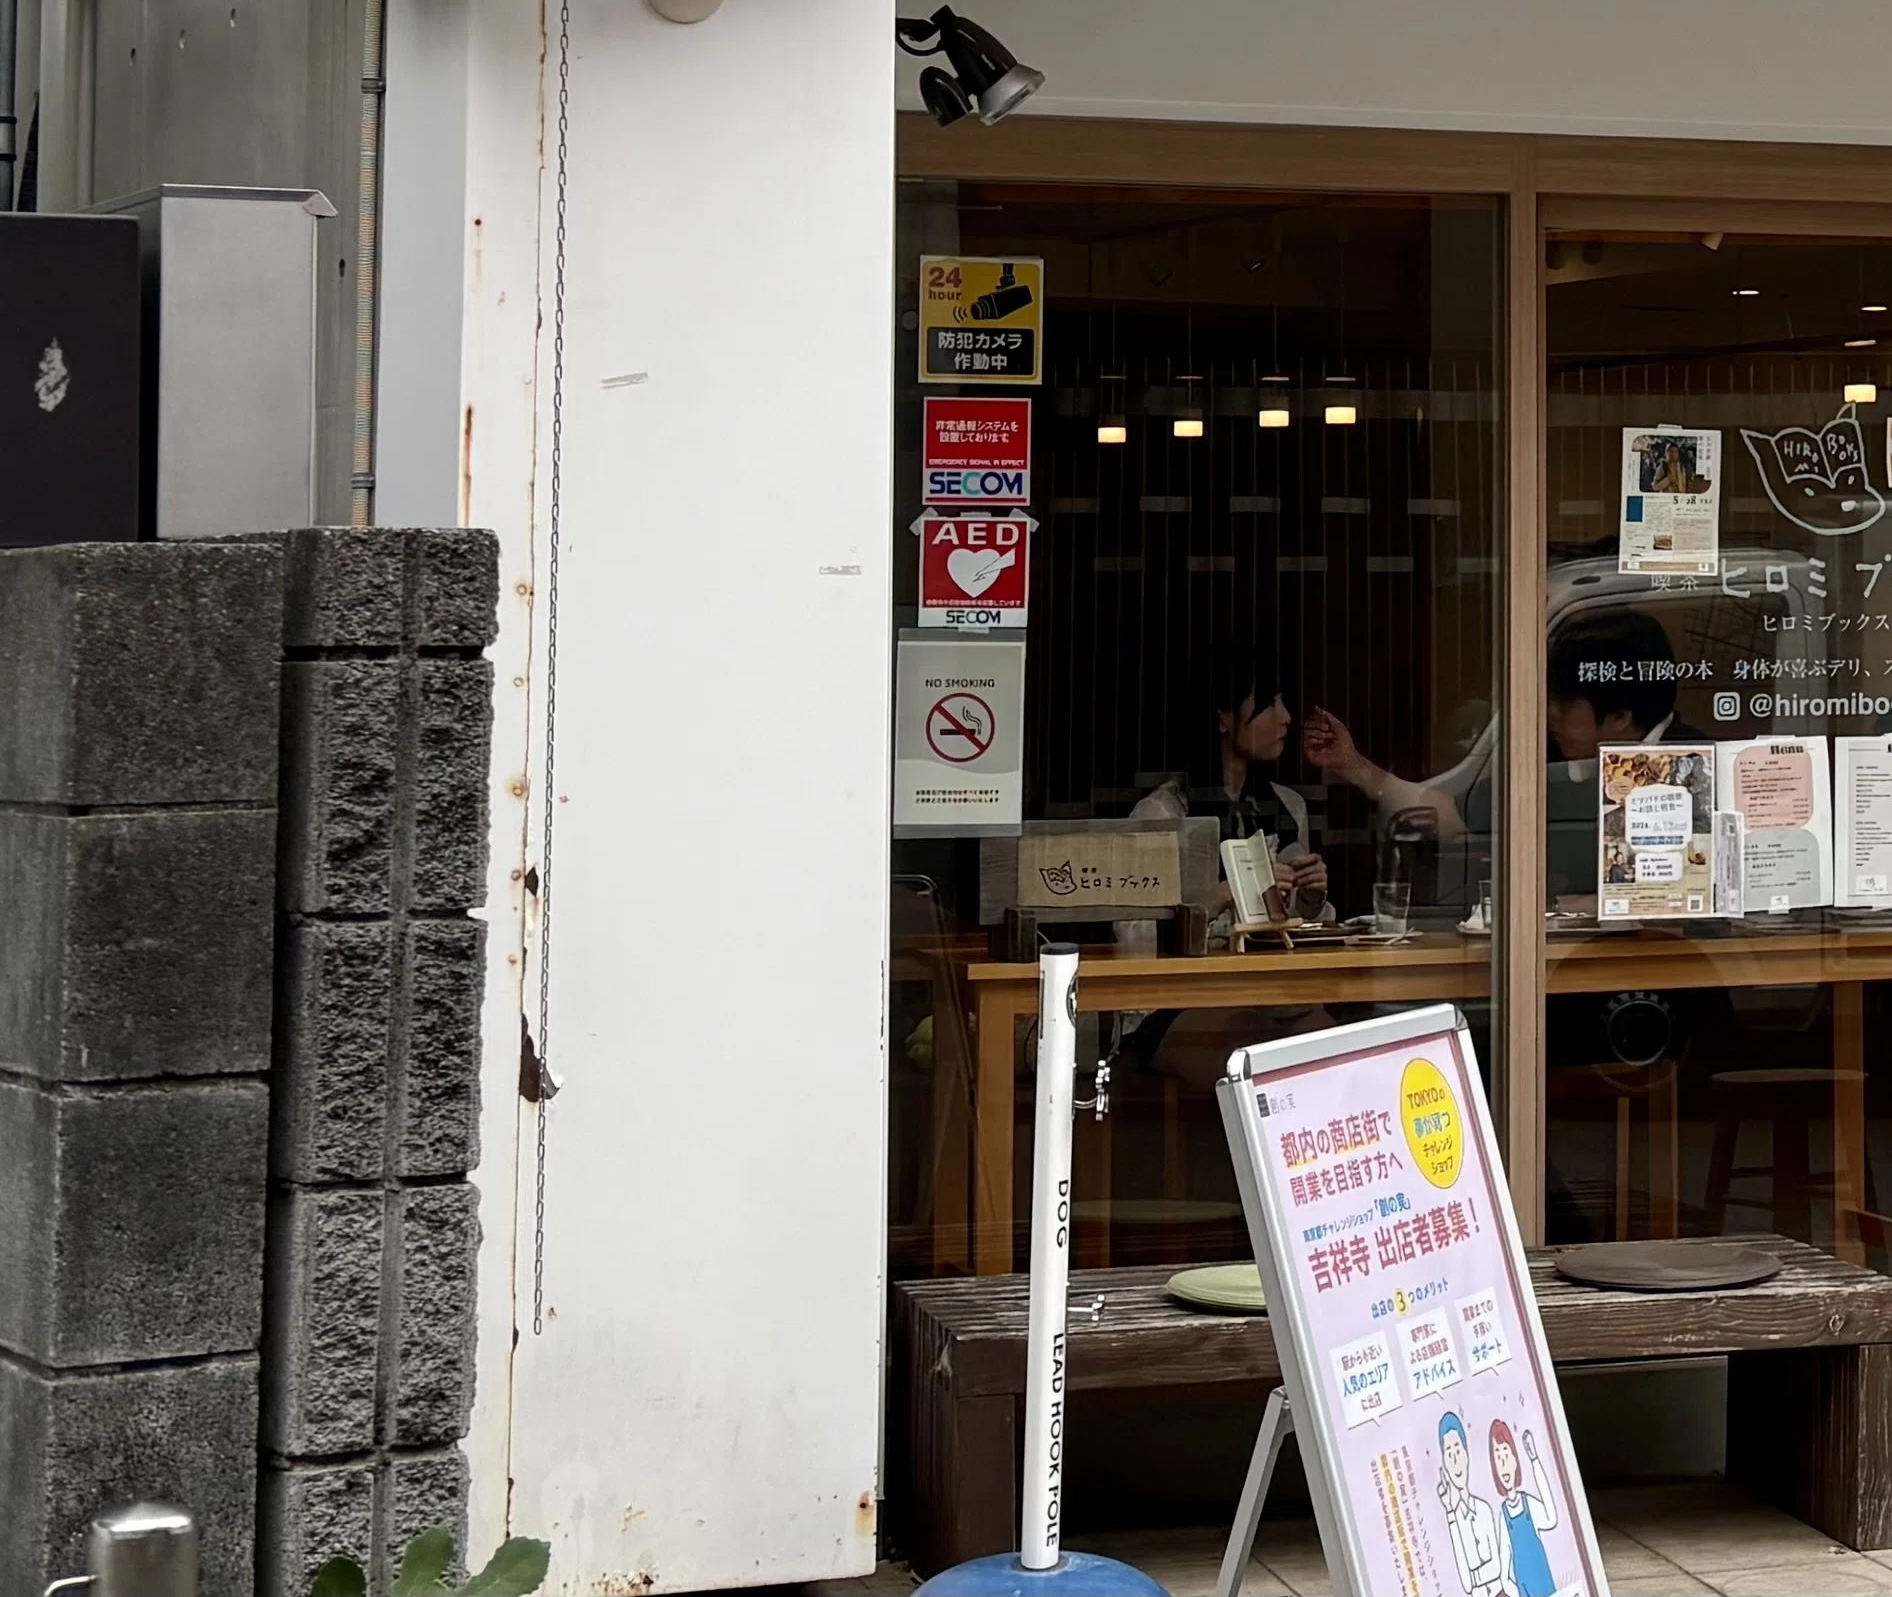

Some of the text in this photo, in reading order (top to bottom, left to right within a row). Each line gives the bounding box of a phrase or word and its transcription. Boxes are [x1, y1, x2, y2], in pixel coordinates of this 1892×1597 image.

[928, 266, 962, 288] 24
[928, 289, 962, 301] hour
[938, 331, 1023, 350] 防犯カメラ
[954, 352, 1008, 371] 作動中
[929, 471, 1023, 496] SECOM
[931, 522, 1020, 546] AED
[946, 610, 1001, 624] SECOM
[1763, 612, 1890, 633] ヒロミブックス
[925, 678, 995, 688] NO SMOKING
[1280, 1107, 1393, 1169] 都内の商店街で
[1289, 1151, 1404, 1207] 開業を目指す方へ
[1307, 1196, 1481, 1294] 吉祥寺 出店者募集！
[1471, 1337, 1503, 1364] サポート
[1046, 1179, 1070, 1549] DOG LEAD HOOK POLE
[1412, 1358, 1457, 1390] アドバイス
[1343, 1362, 1390, 1398] 人気のエリア
